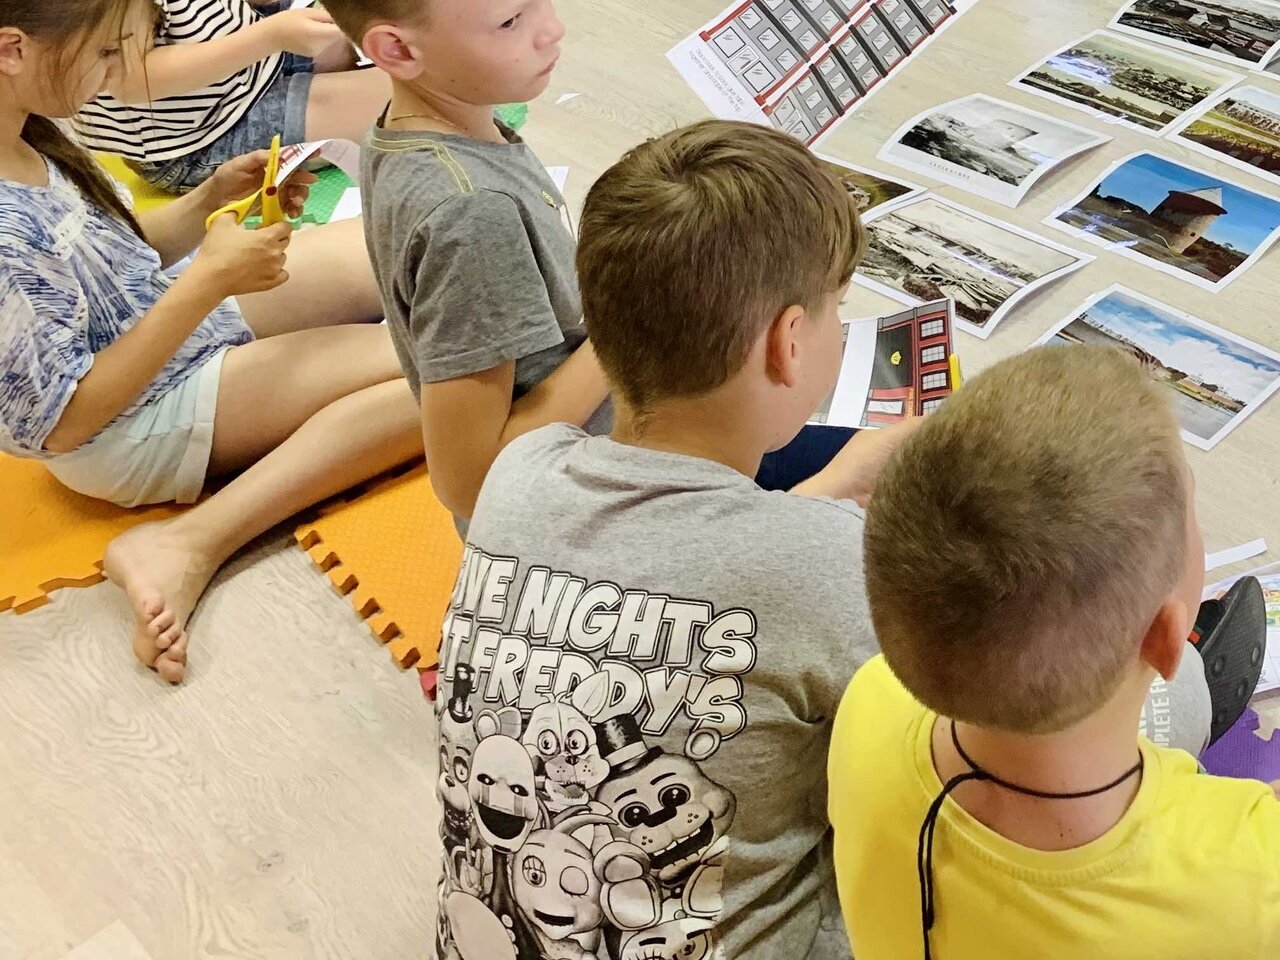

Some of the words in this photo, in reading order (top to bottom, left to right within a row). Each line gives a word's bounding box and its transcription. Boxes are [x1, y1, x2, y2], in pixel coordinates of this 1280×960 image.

[453, 543, 519, 623] IVE
[511, 566, 757, 676] NIGHTS
[470, 628, 747, 741] FREDDY'S
